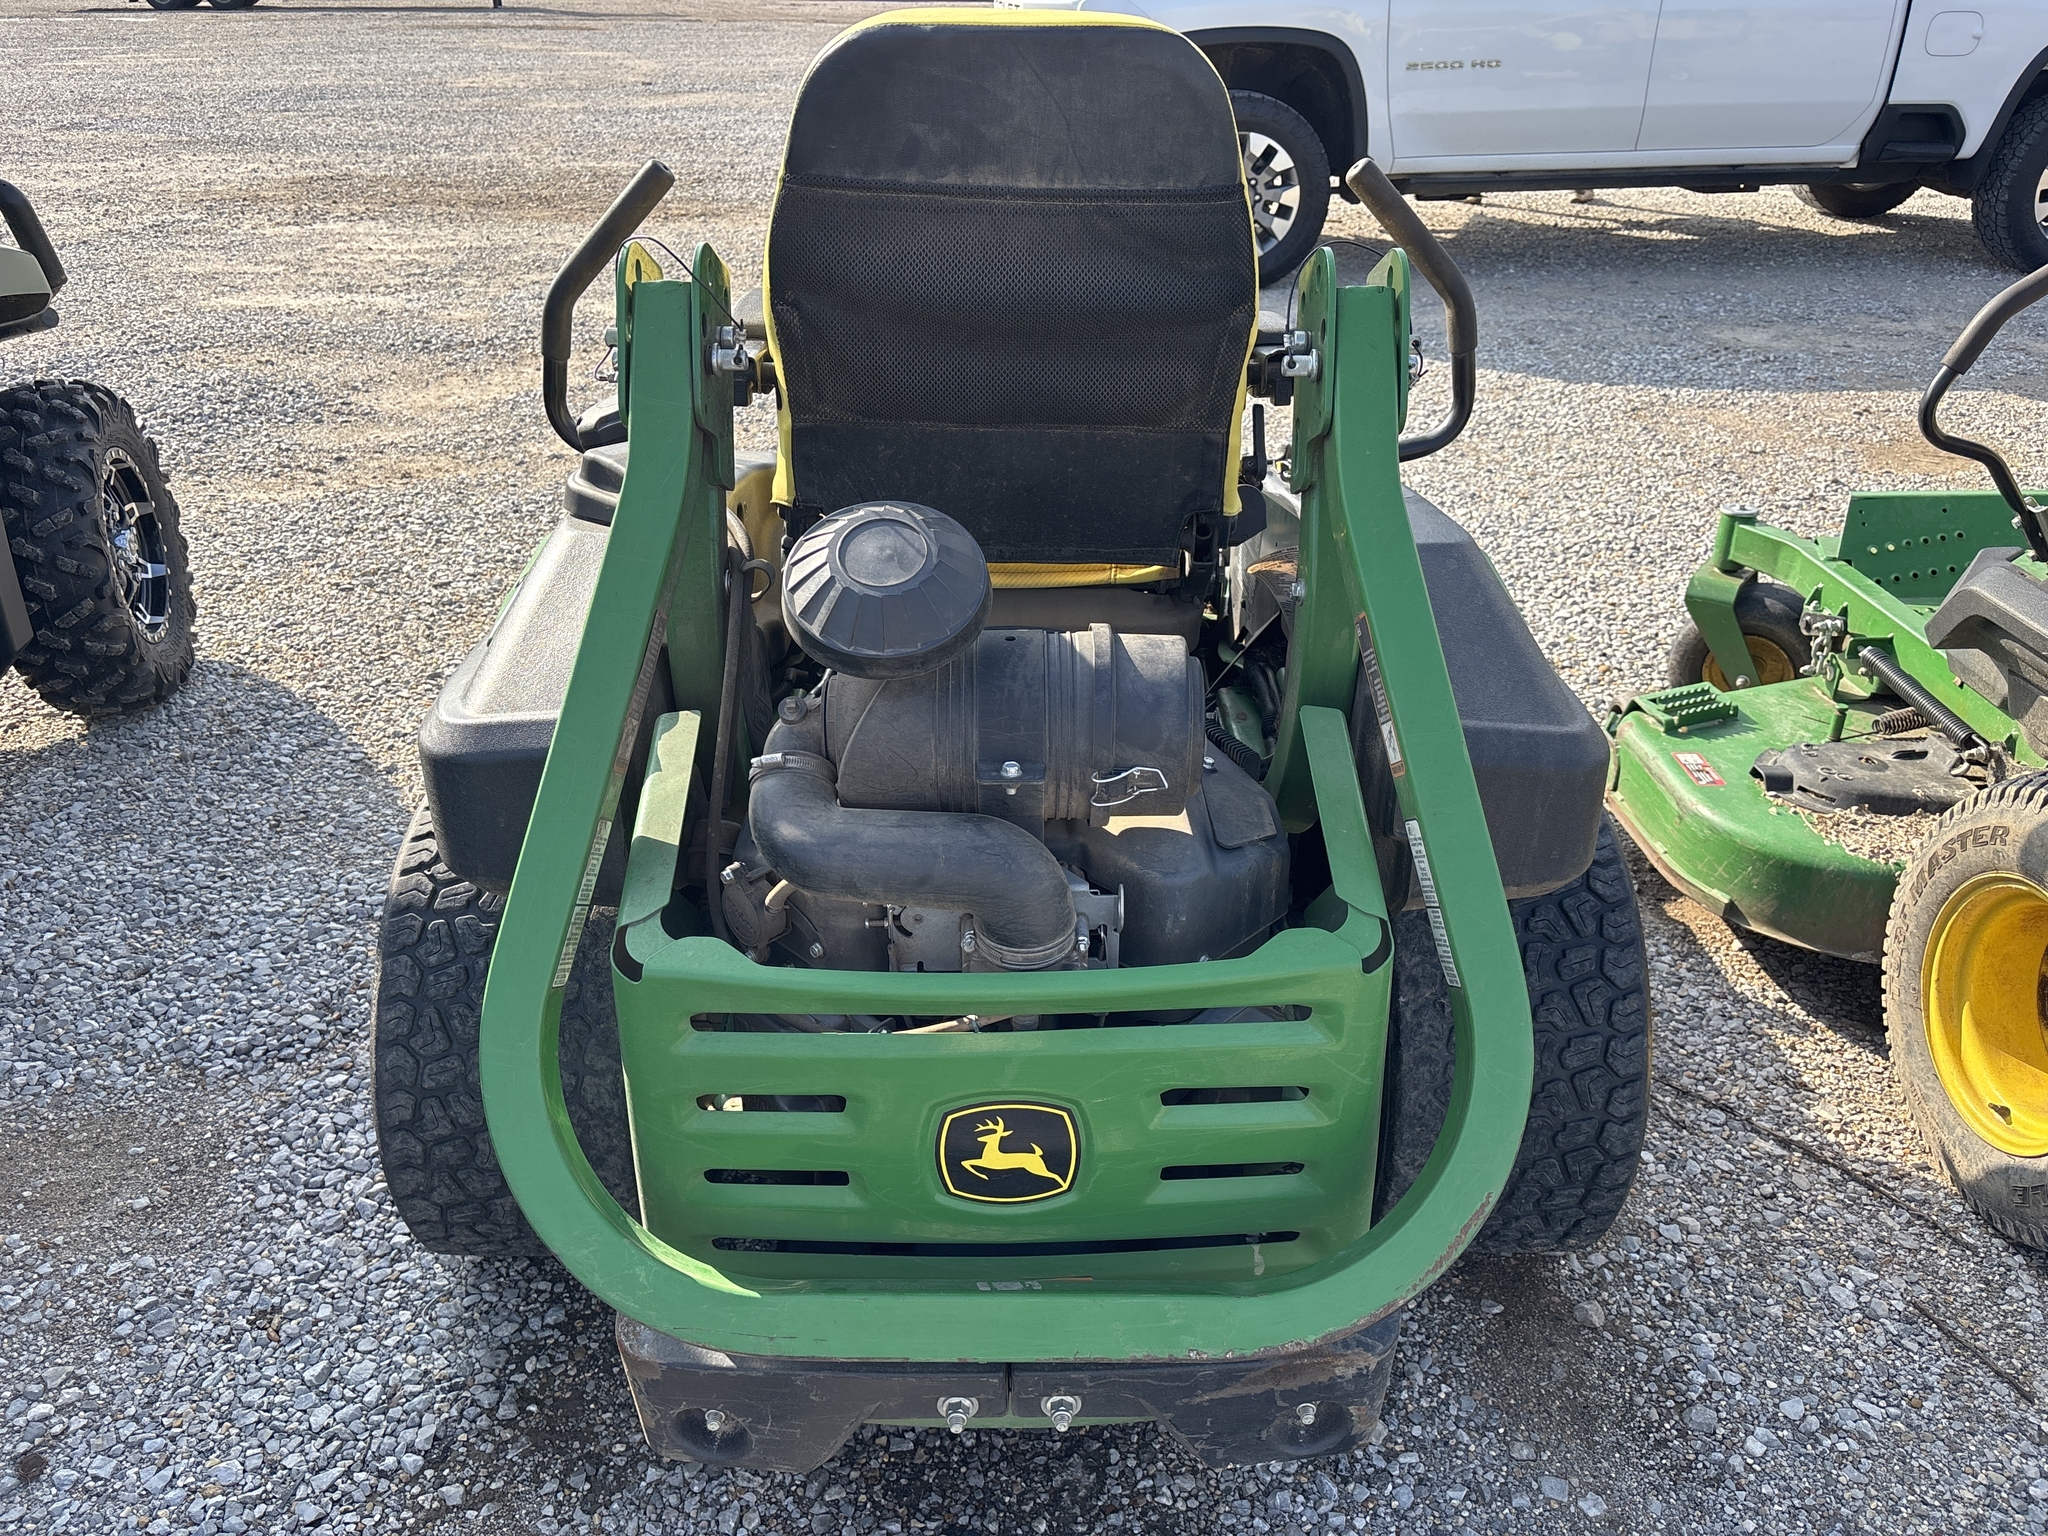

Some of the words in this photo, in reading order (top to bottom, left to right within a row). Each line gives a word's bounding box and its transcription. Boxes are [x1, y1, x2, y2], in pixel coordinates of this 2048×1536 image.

[1405, 61, 1464, 71] 2500
[1470, 59, 1502, 69] HD
[1909, 825, 2010, 906] MASTER
